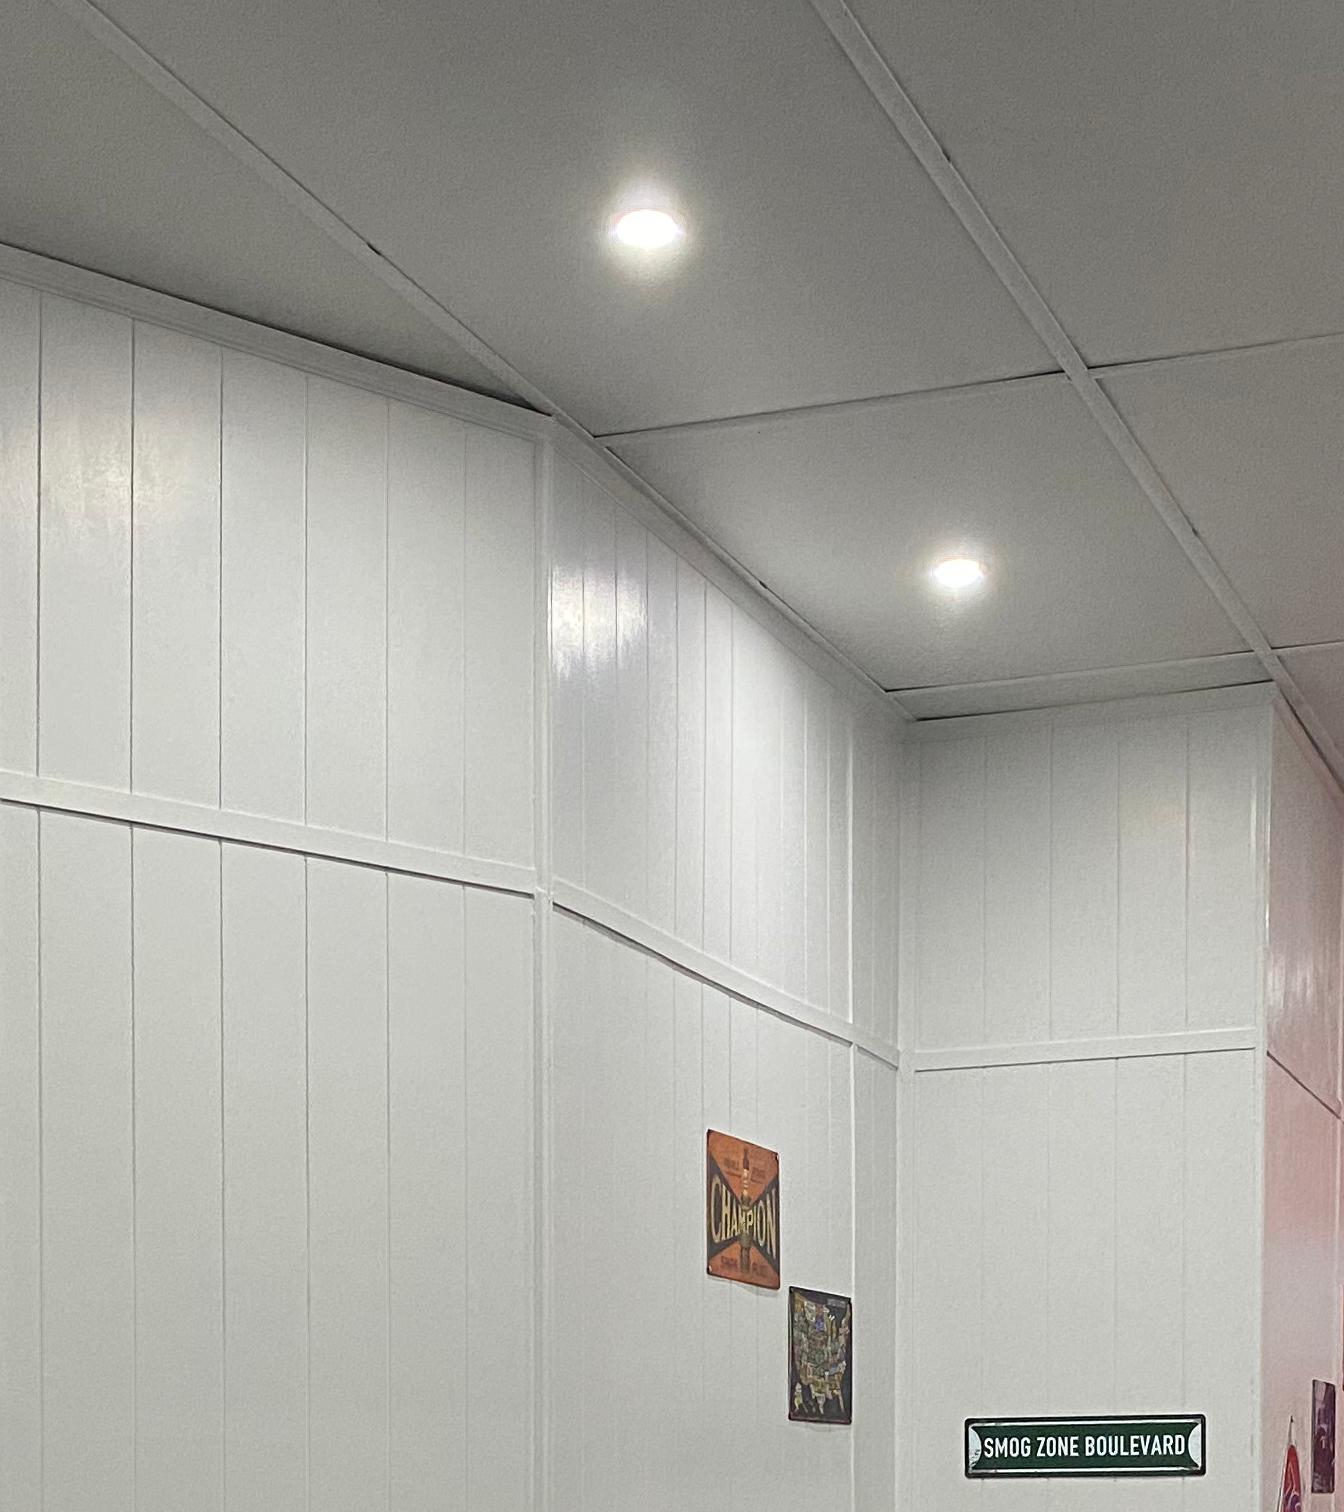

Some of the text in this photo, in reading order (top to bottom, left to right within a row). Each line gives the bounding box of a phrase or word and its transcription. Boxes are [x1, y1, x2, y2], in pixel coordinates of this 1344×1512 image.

[711, 1173, 777, 1260] CHAMPION
[983, 1434, 1185, 1459] SMOG ZONE BOULEVARD
